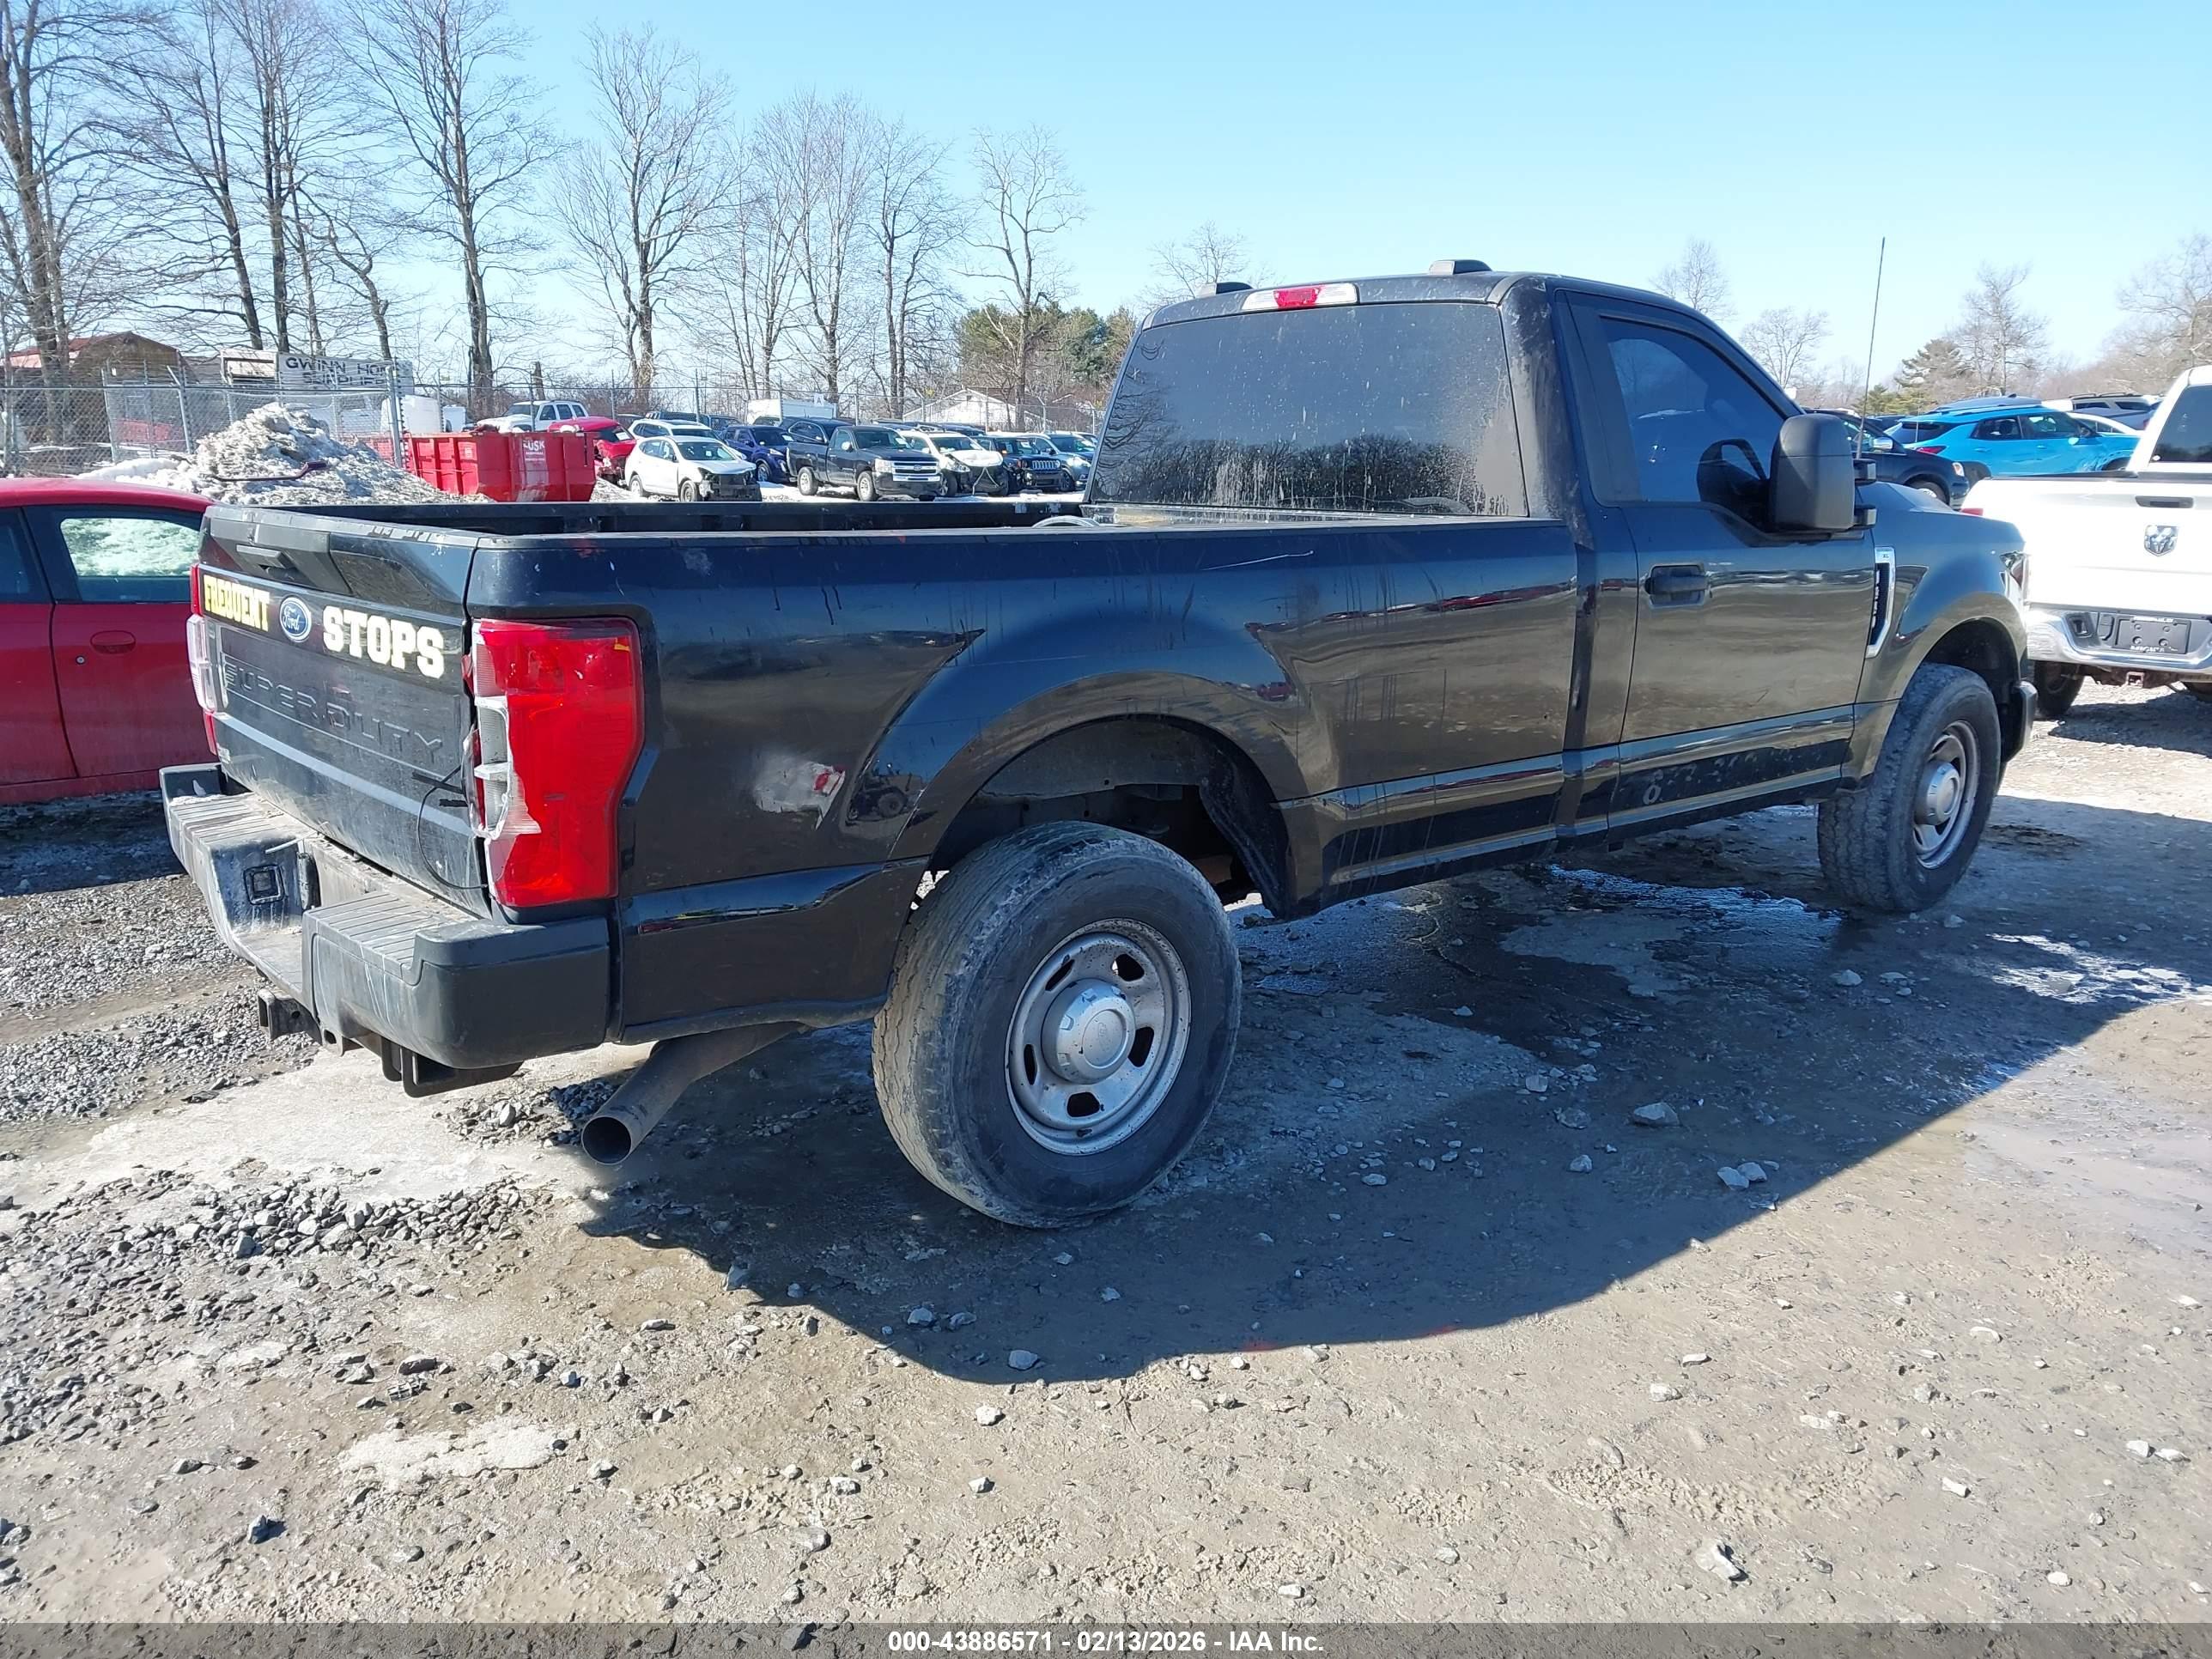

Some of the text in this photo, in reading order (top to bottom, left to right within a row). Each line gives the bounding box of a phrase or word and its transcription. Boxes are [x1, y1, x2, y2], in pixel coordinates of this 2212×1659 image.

[286, 357, 346, 374] GWINN
[203, 574, 445, 678] FREQUENT STOPS
[283, 605, 301, 632] Ford
